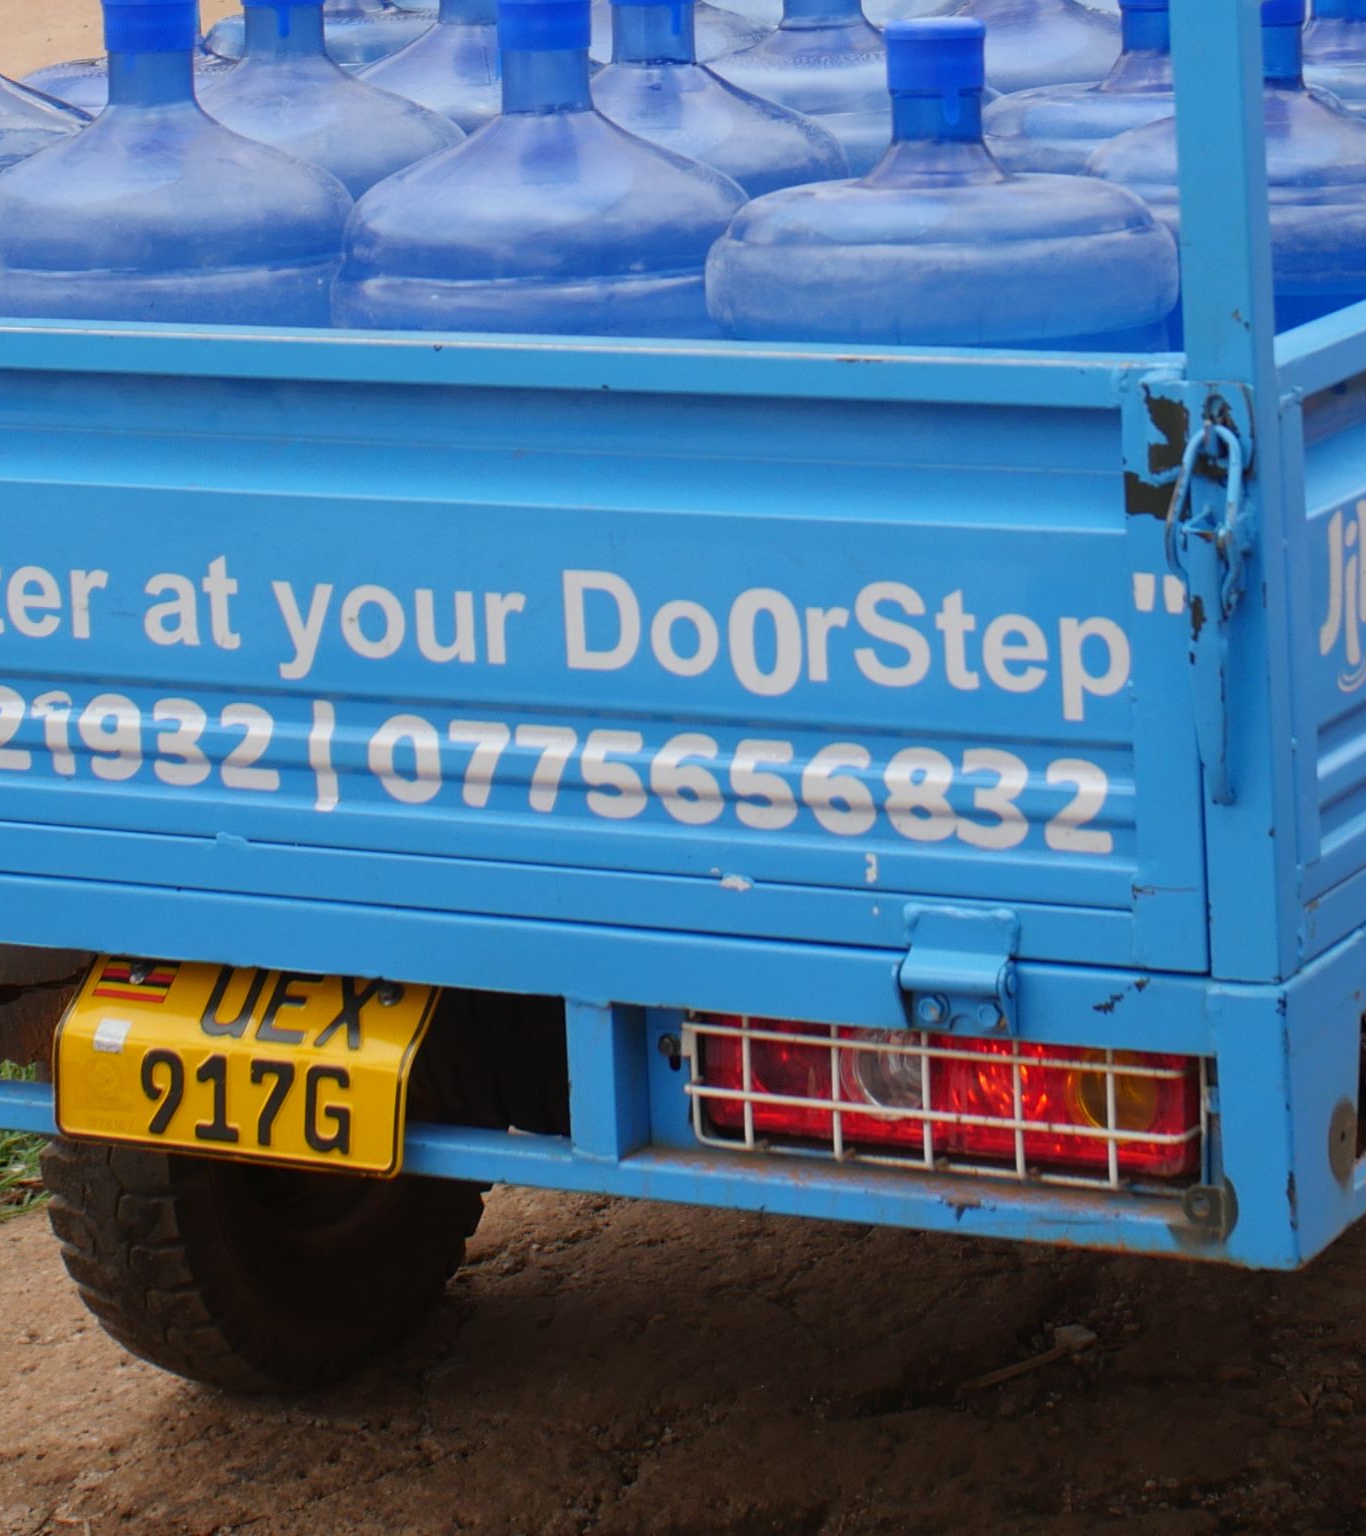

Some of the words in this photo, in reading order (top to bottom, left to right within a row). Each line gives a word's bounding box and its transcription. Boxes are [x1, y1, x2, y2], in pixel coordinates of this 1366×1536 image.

[143, 555, 242, 652] at
[272, 578, 525, 680] your
[367, 713, 1115, 855] 0775656832
[200, 965, 383, 1051] UEX
[140, 1047, 352, 1156] 917G
